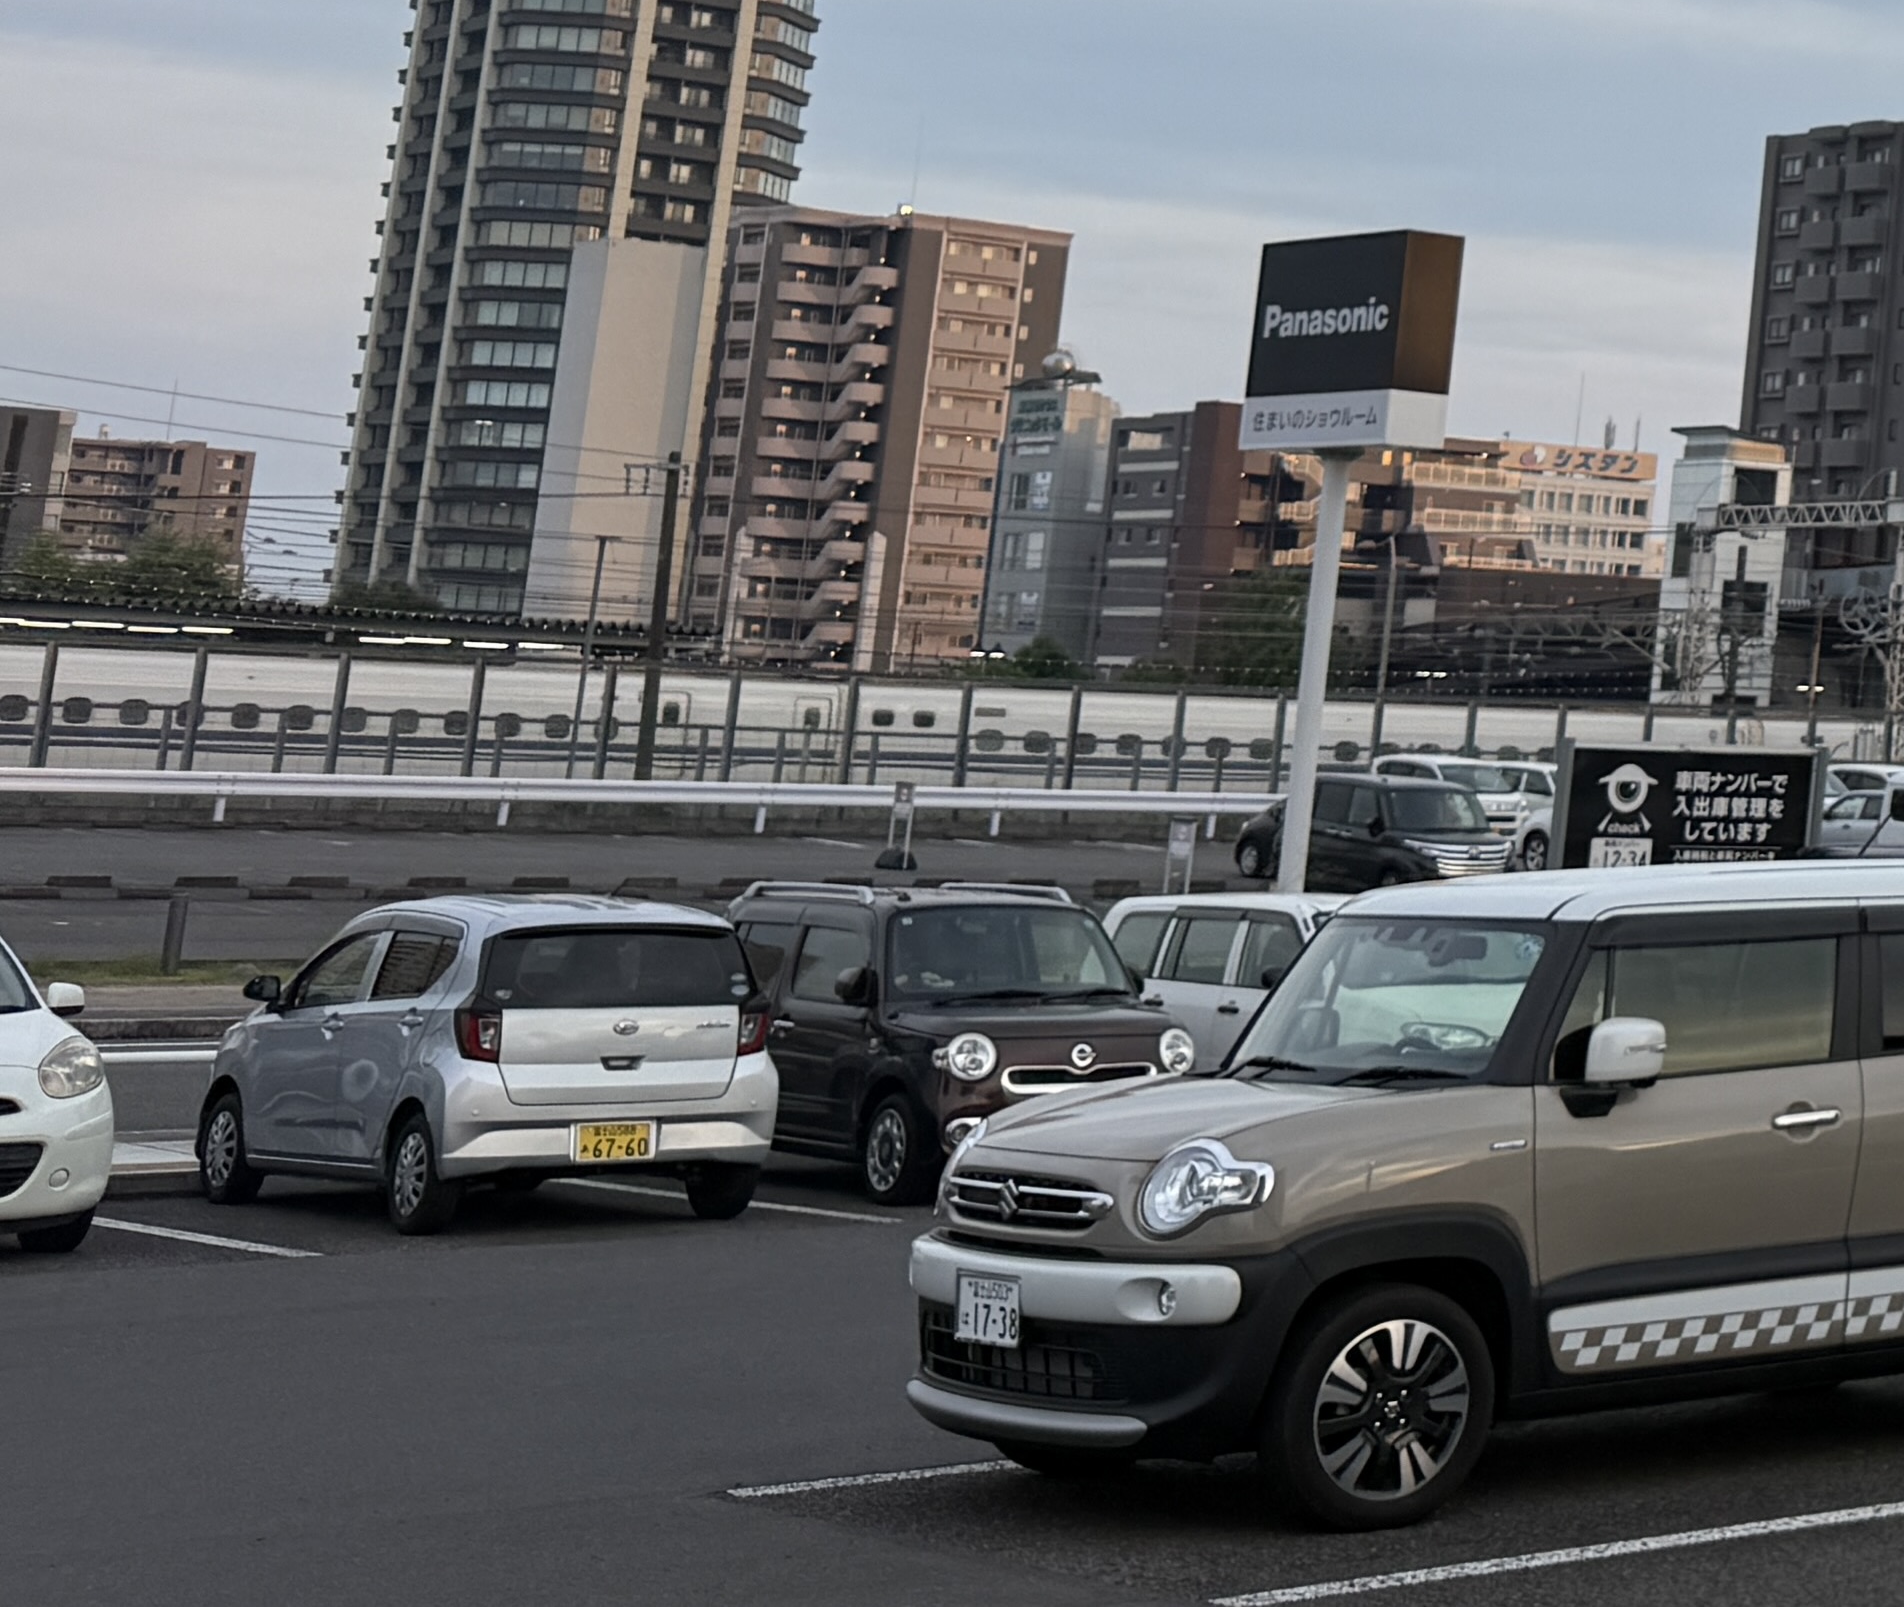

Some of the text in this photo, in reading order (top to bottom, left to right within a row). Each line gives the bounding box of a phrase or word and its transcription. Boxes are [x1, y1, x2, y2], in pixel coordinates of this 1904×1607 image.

[1263, 297, 1389, 338] Panasonic
[1252, 405, 1378, 432] 住まいのショウルーム
[1553, 449, 1639, 474] シスタン
[1674, 771, 1788, 793] 車両ナンバーで
[1673, 795, 1785, 818] 入出庫管理を
[1607, 822, 1640, 834] check
[1685, 820, 1772, 843] しています
[592, 1137, 648, 1159] 67-60
[973, 1302, 1018, 1341] 17-38
